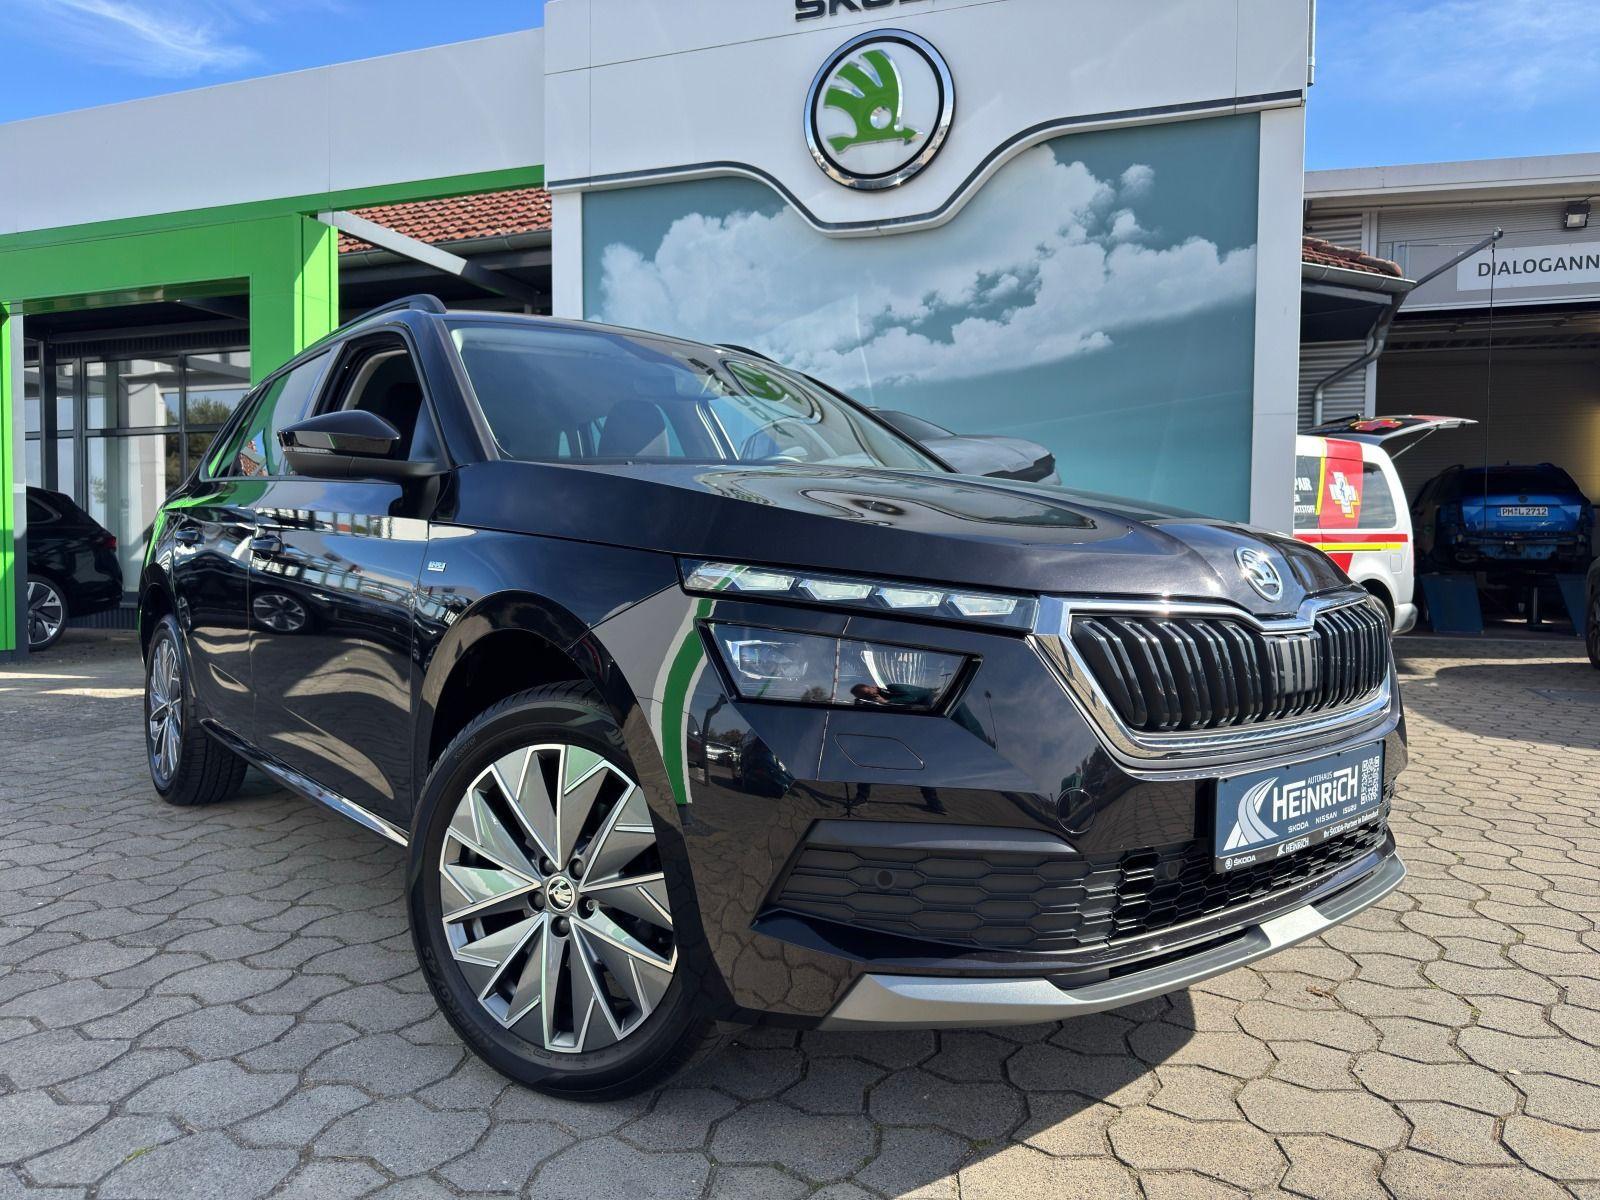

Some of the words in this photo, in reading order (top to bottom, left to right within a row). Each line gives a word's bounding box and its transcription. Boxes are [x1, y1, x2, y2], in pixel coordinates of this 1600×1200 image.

[1307, 771, 1333, 785] AUTOHAUS
[1315, 811, 1338, 825] NISSAN
[1342, 804, 1357, 815] ISUZU
